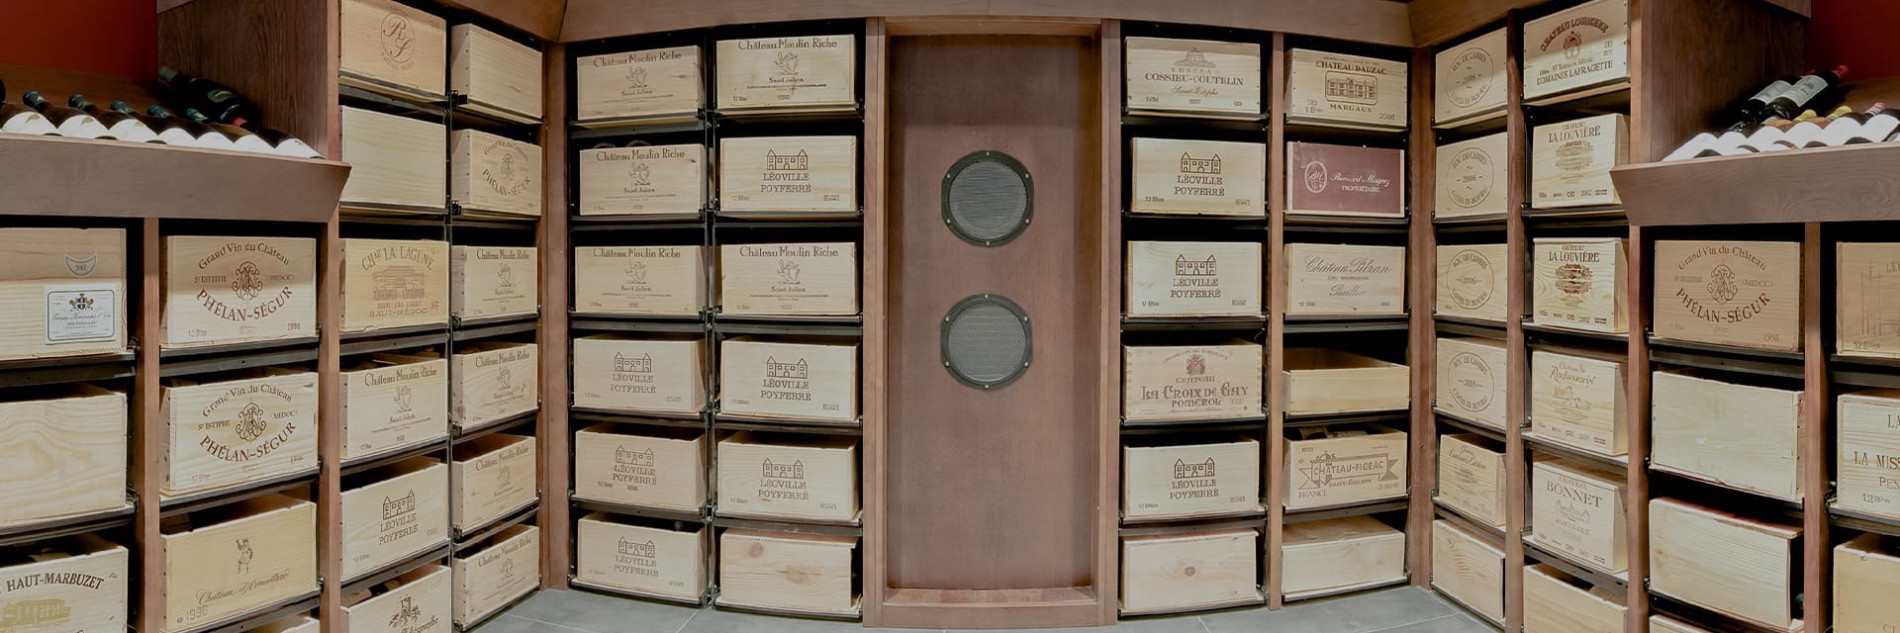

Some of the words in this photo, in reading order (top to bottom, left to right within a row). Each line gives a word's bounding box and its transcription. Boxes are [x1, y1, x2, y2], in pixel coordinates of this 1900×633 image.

[737, 39, 777, 50] Château
[778, 38, 810, 49] Moulin
[812, 37, 838, 48] Riche
[1355, 64, 1389, 75] DAUZAC
[1329, 103, 1373, 113] MARGAUX
[595, 151, 631, 162] Château
[632, 149, 660, 160] Moulin
[662, 148, 685, 159] Riche
[762, 172, 810, 182] LÉOVILLE
[1176, 174, 1224, 186] LÉOVILLE
[198, 244, 227, 270] Grand
[226, 242, 243, 253] Vin
[244, 242, 256, 252] du
[592, 248, 627, 258] Château
[658, 247, 681, 258] Riche
[739, 245, 778, 257] Château
[779, 245, 811, 257] Moulin
[812, 245, 839, 257] Riche
[1548, 251, 1559, 262] LA
[400, 246, 435, 271] LAGUNE
[1678, 248, 1702, 270] Grand
[1702, 246, 1717, 257] Vin
[1718, 245, 1730, 255] du
[1732, 246, 1767, 271] Château
[1172, 276, 1219, 287] LÉOVILLE
[364, 372, 395, 387] Château
[396, 369, 419, 382] Moulin
[762, 378, 810, 390] LÉOVILLE
[230, 386, 246, 397] Vin
[1853, 450, 1868, 466] LA
[1546, 479, 1603, 508] BONNET
[6, 572, 105, 593] HAUT-MARBUZET
